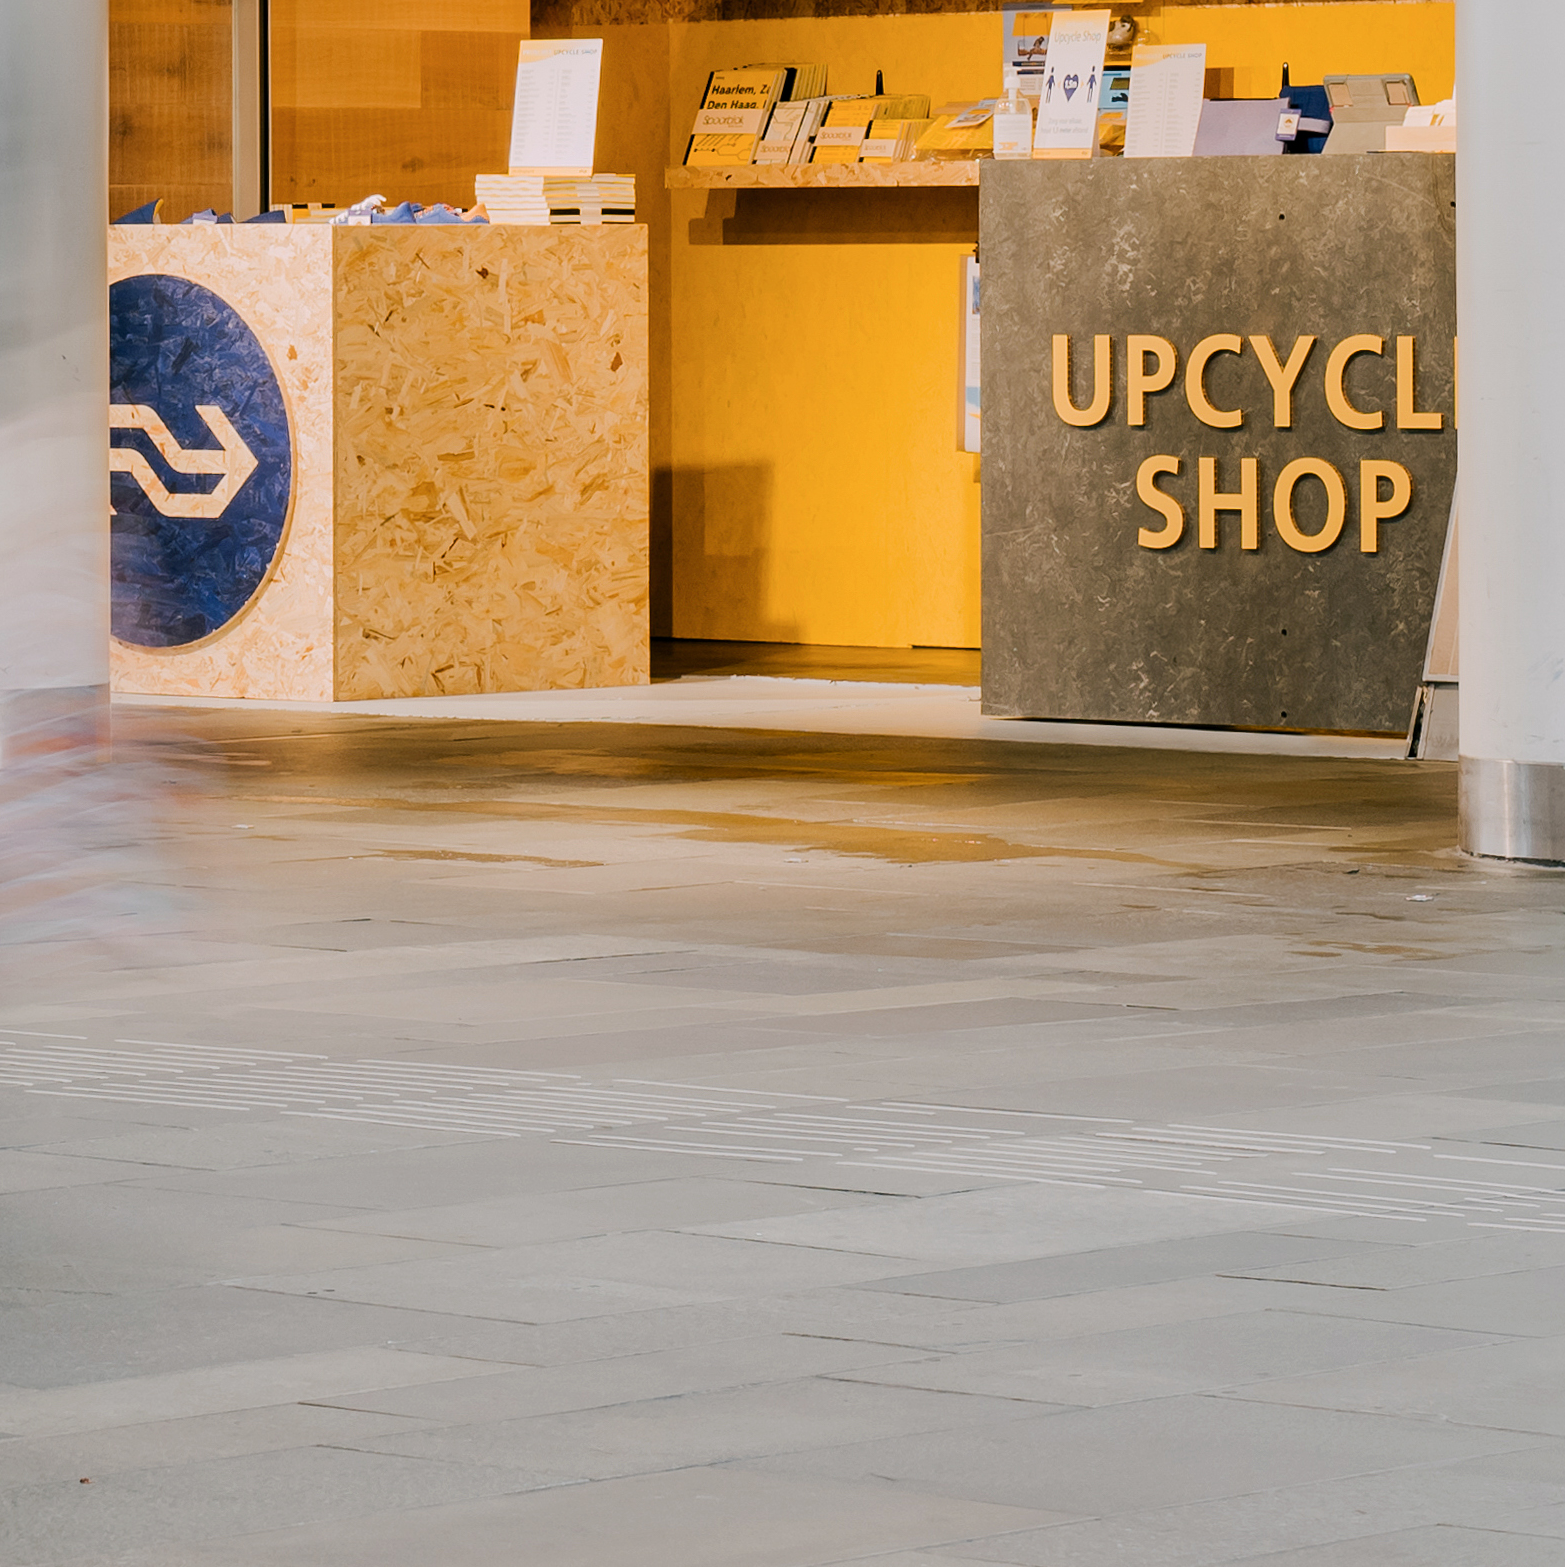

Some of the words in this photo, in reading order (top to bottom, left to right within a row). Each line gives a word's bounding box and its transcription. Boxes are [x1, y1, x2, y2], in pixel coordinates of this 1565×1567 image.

[1082, 30, 1102, 43] Shop
[706, 100, 728, 109] Den
[1051, 334, 1458, 430] UPCYCL
[1136, 454, 1413, 553] SHOP
